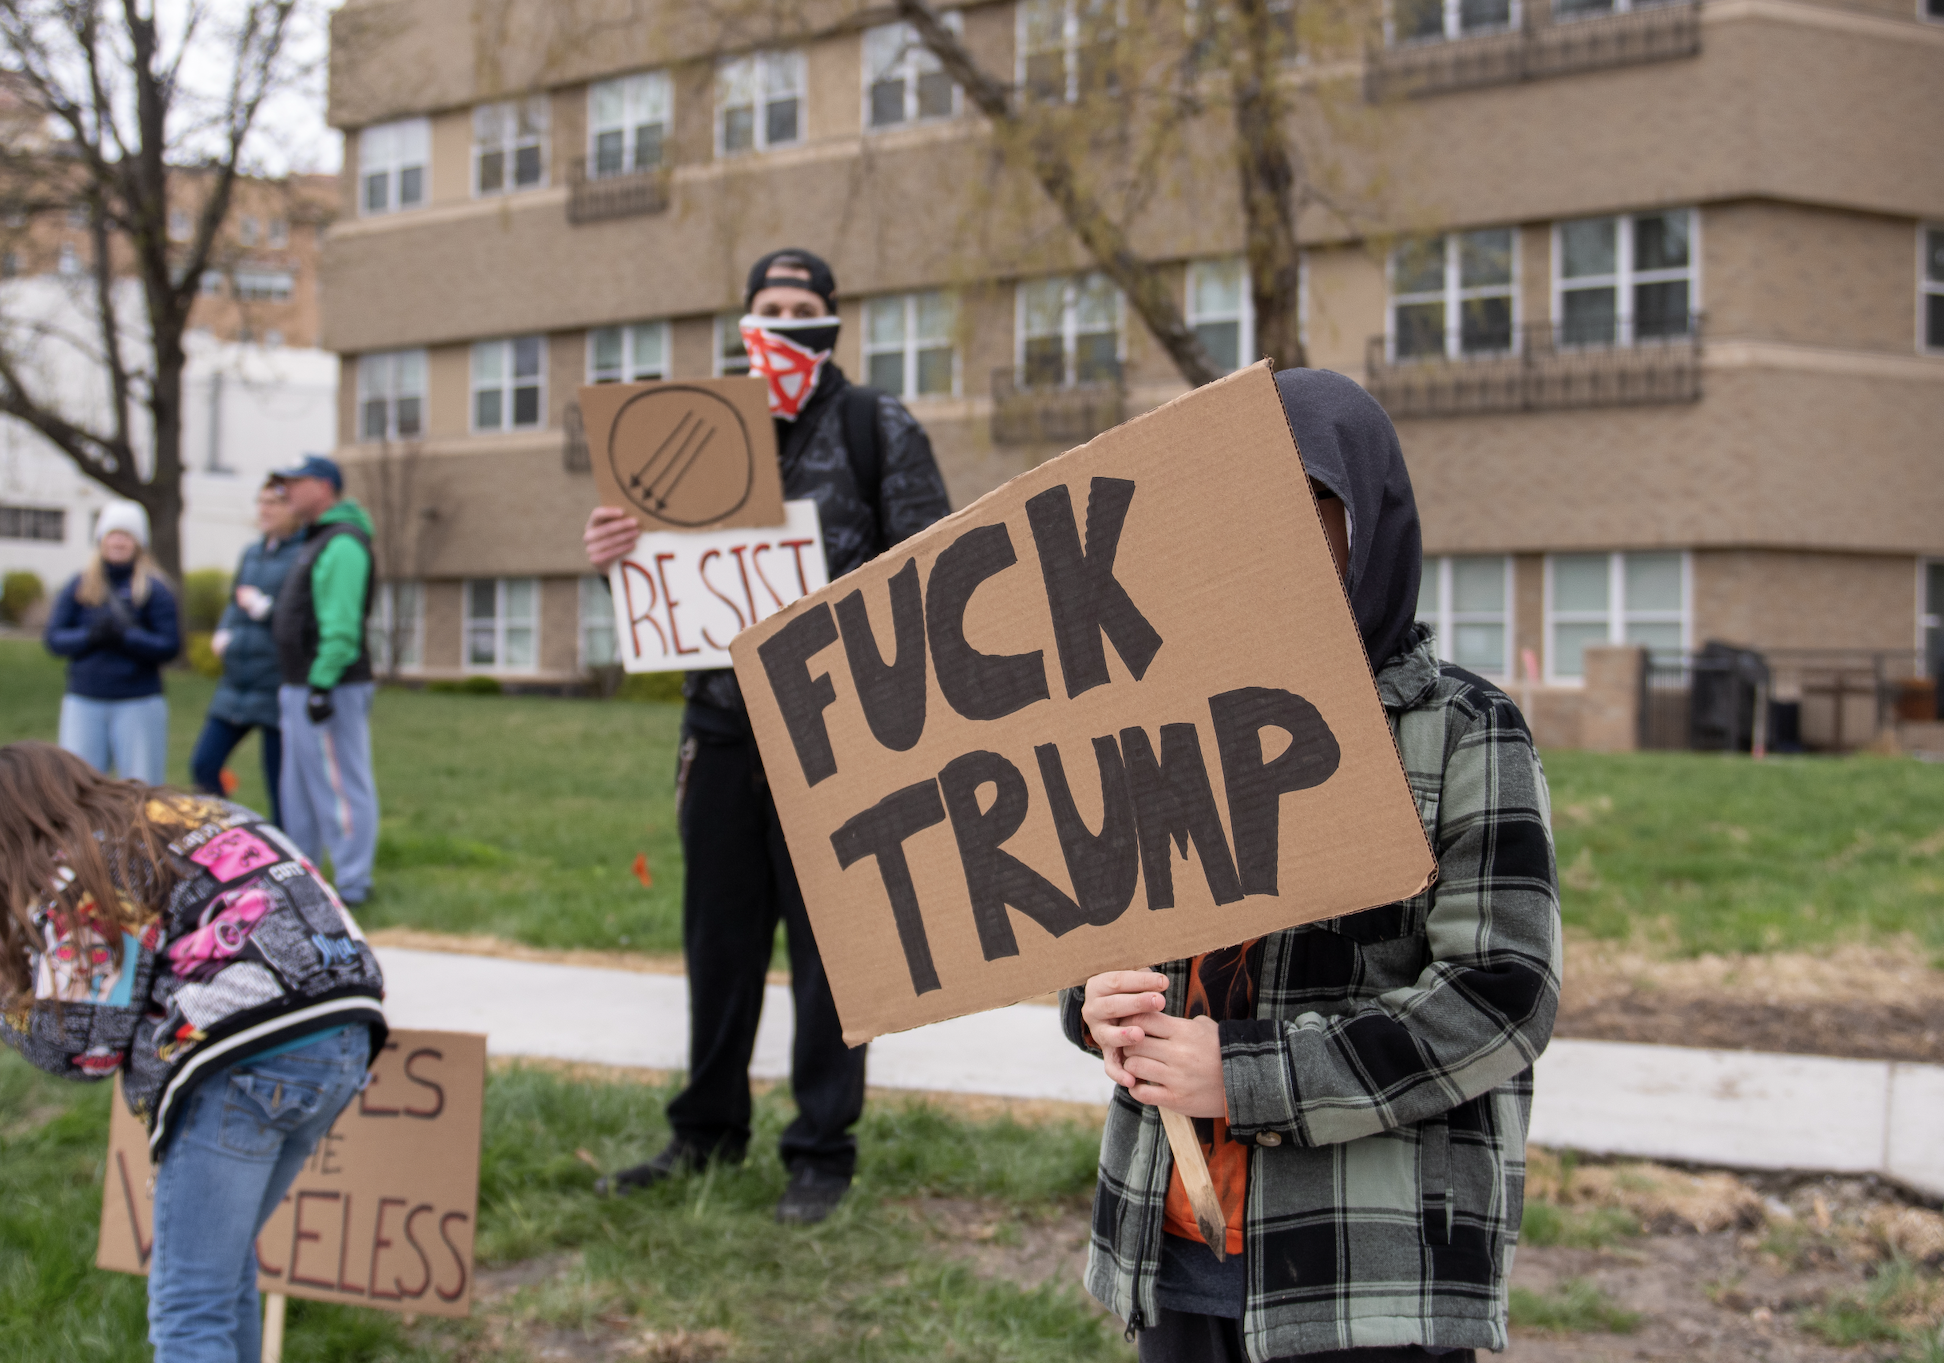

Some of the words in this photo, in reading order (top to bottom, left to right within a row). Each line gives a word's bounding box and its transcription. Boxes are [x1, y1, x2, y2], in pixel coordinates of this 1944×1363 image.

[622, 539, 815, 658] RESIST
[757, 477, 1163, 788] FUCK
[830, 686, 1341, 997] TRUMP
